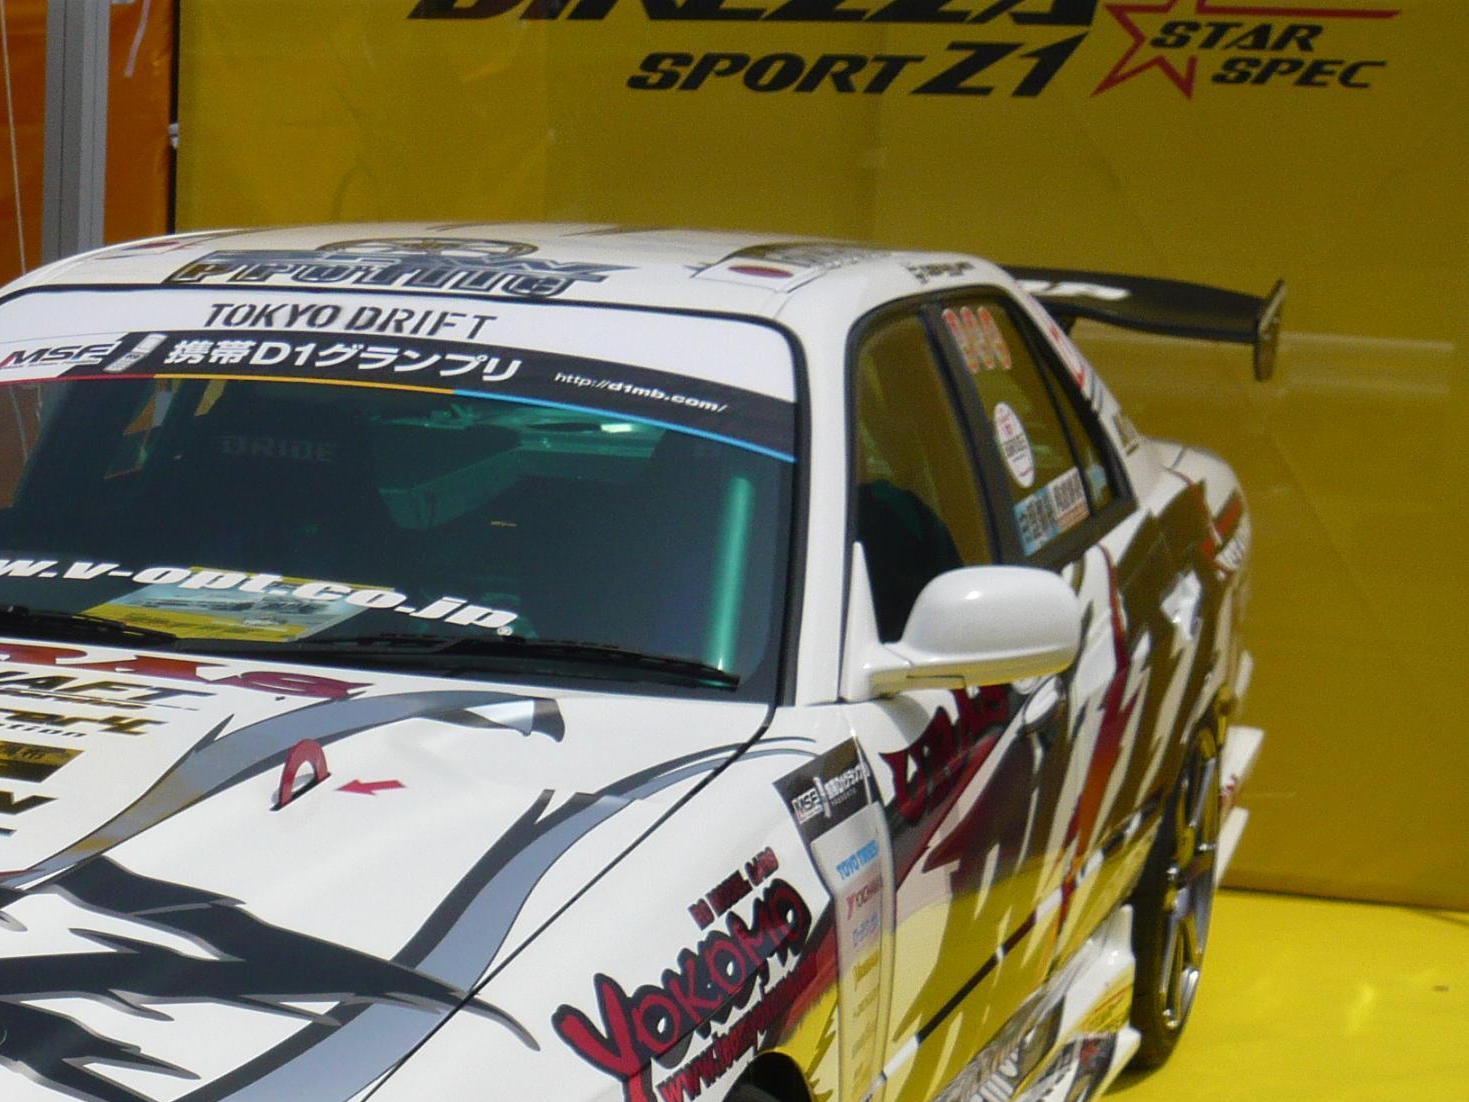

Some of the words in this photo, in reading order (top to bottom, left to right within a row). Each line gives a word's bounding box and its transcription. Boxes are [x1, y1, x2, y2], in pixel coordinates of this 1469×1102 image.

[1149, 20, 1326, 52] STAR
[625, 51, 927, 95] SPORT
[907, 31, 1093, 99] Z1
[1211, 56, 1389, 90] SPEC
[204, 302, 345, 330] TOKYO
[344, 306, 498, 341] DRIFT
[164, 338, 523, 384] 携帯D1グランプリ
[553, 371, 729, 414] http://d1mb.com/
